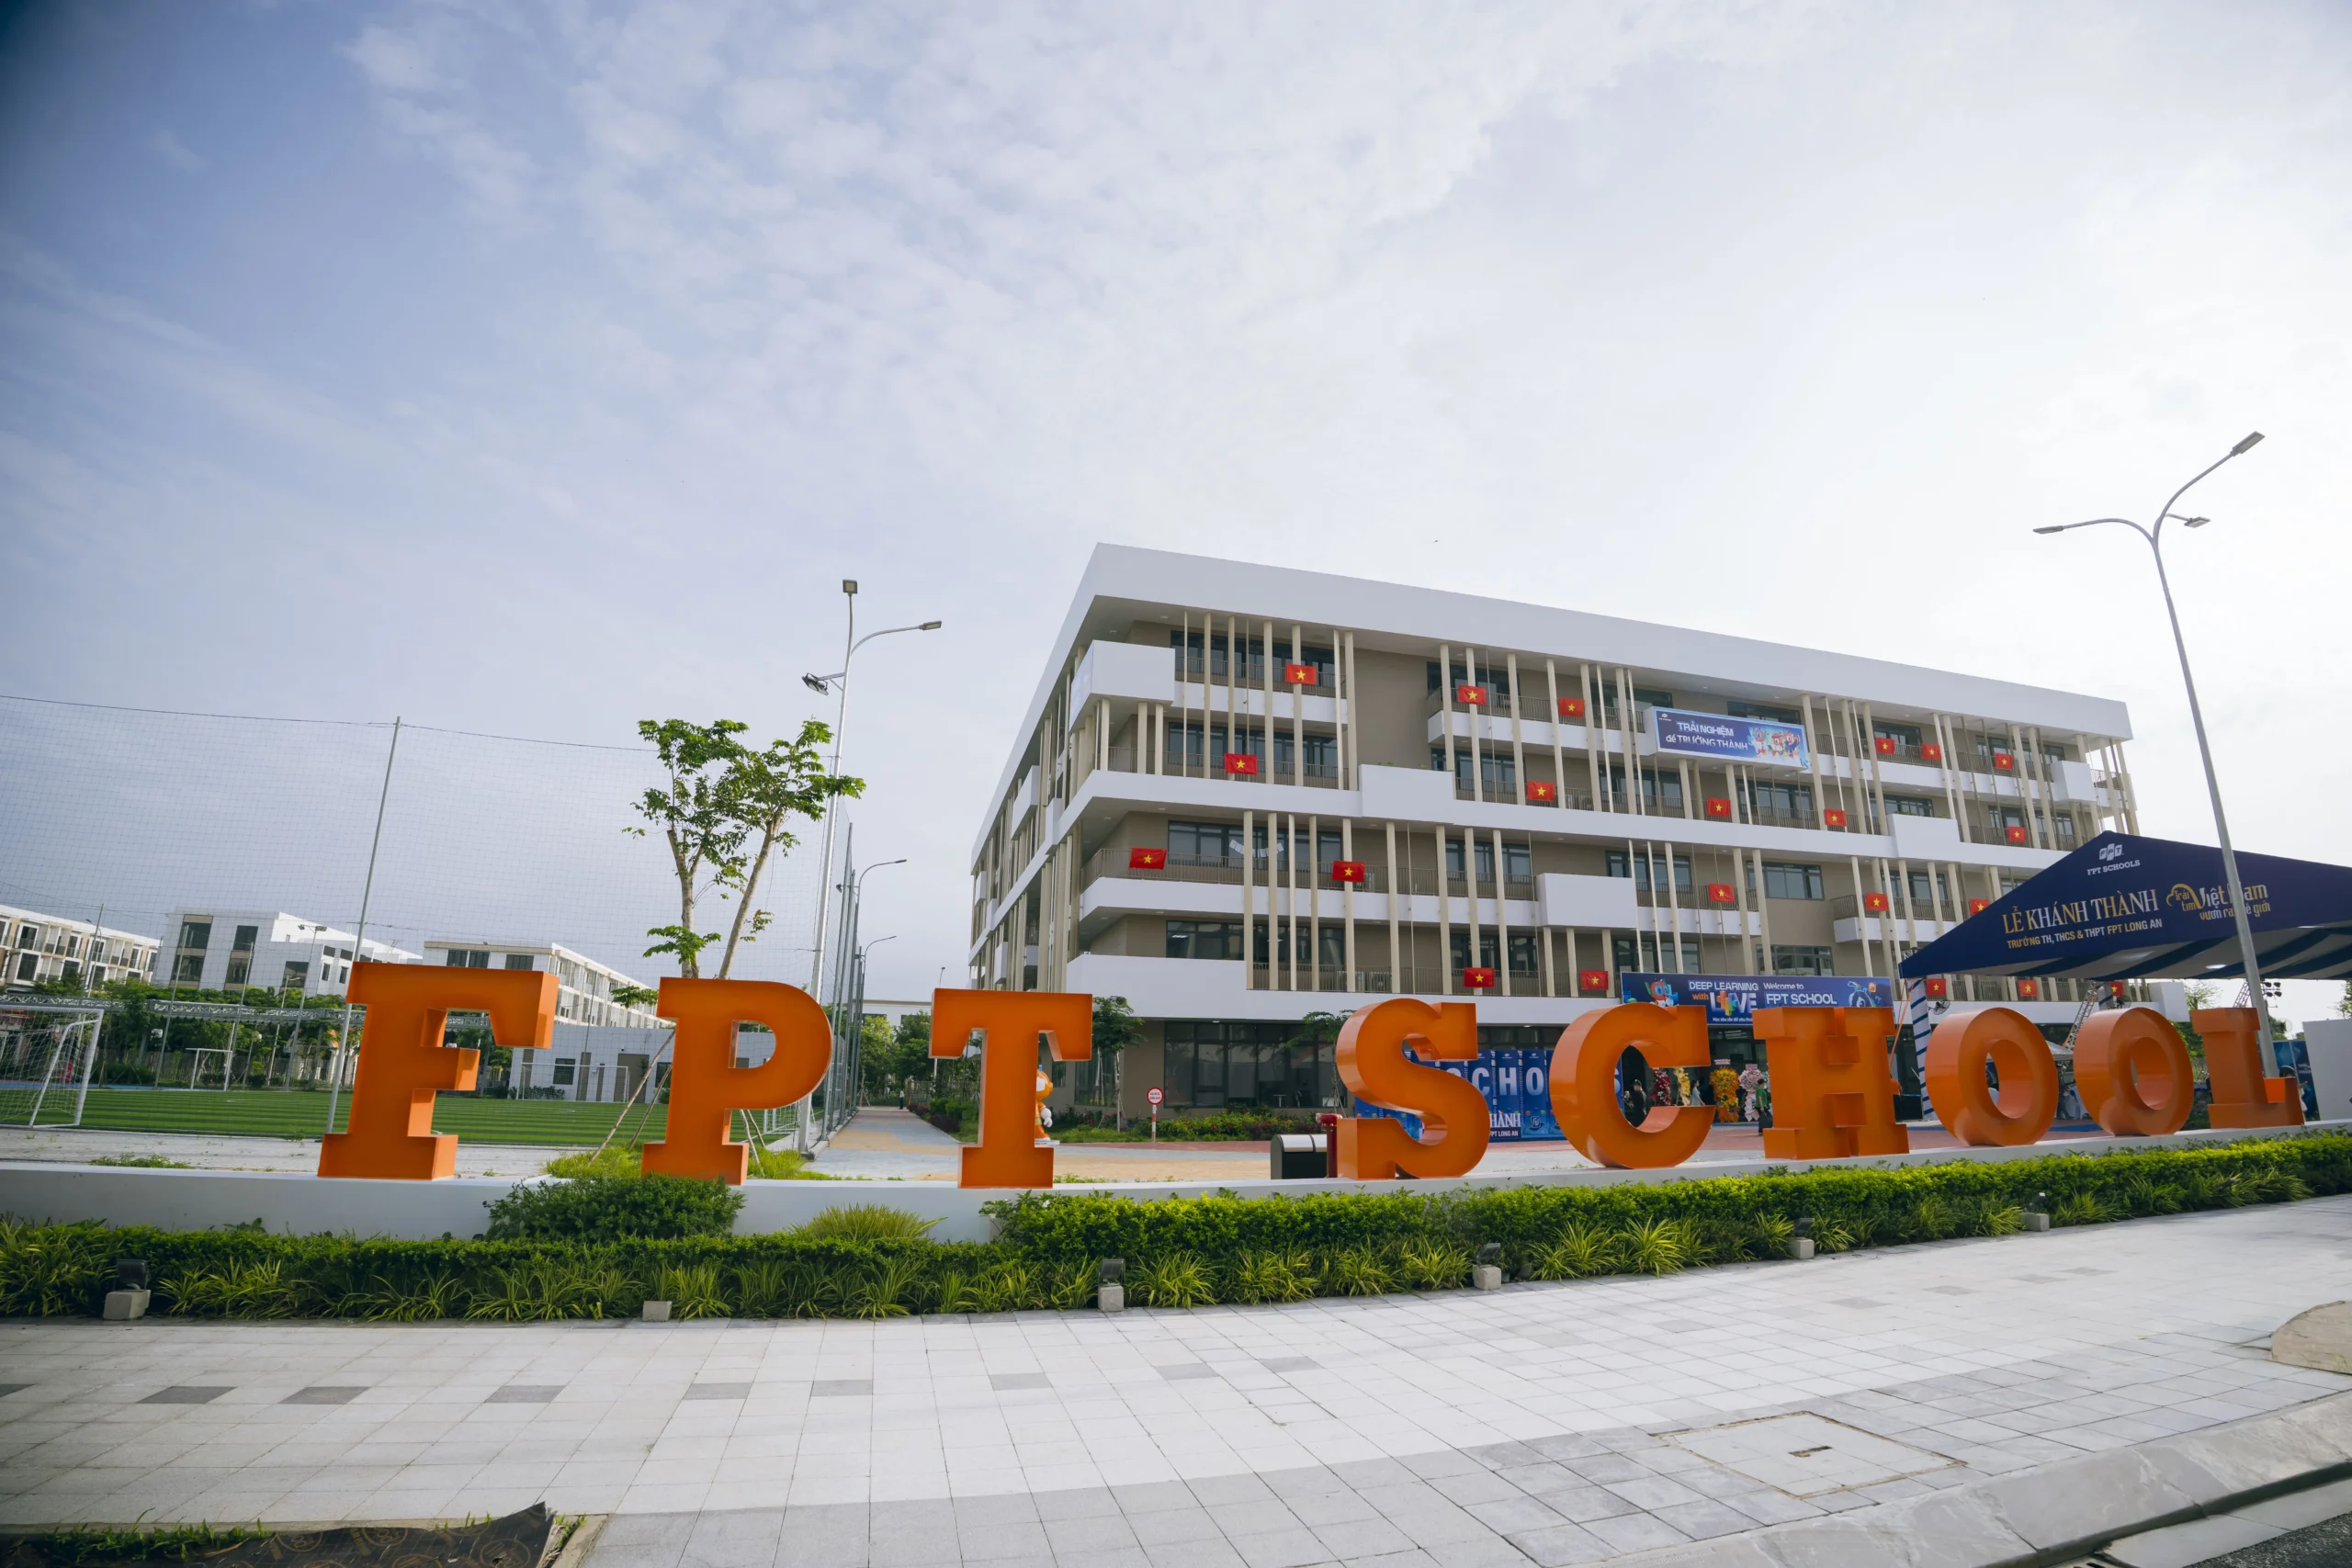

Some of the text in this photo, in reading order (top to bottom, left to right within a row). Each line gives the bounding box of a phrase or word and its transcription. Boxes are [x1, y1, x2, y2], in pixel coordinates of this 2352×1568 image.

[1700, 724, 1734, 738] NGHIỆM
[2098, 842, 2123, 862] FPT
[2086, 859, 2141, 875] FPT SCHOOLS
[2001, 889, 2159, 934] LỄ KHÁNH THÀNH
[2041, 933, 2055, 945] TH,
[2055, 931, 2076, 943] THCS
[2076, 930, 2085, 940] &
[2084, 926, 2107, 939] THPT
[2107, 924, 2123, 935] FPT
[2124, 920, 2148, 932] LONG
[2149, 918, 2164, 930] AN
[1689, 981, 1759, 991] DEEP LEARNING
[1763, 982, 1796, 990] Welcome
[1691, 992, 1710, 1000] with
[1766, 993, 1838, 1005] FPT SCHOOL
[318, 962, 2304, 1190] FPT SCHOOL
[1488, 1110, 1521, 1128] HÀNH
